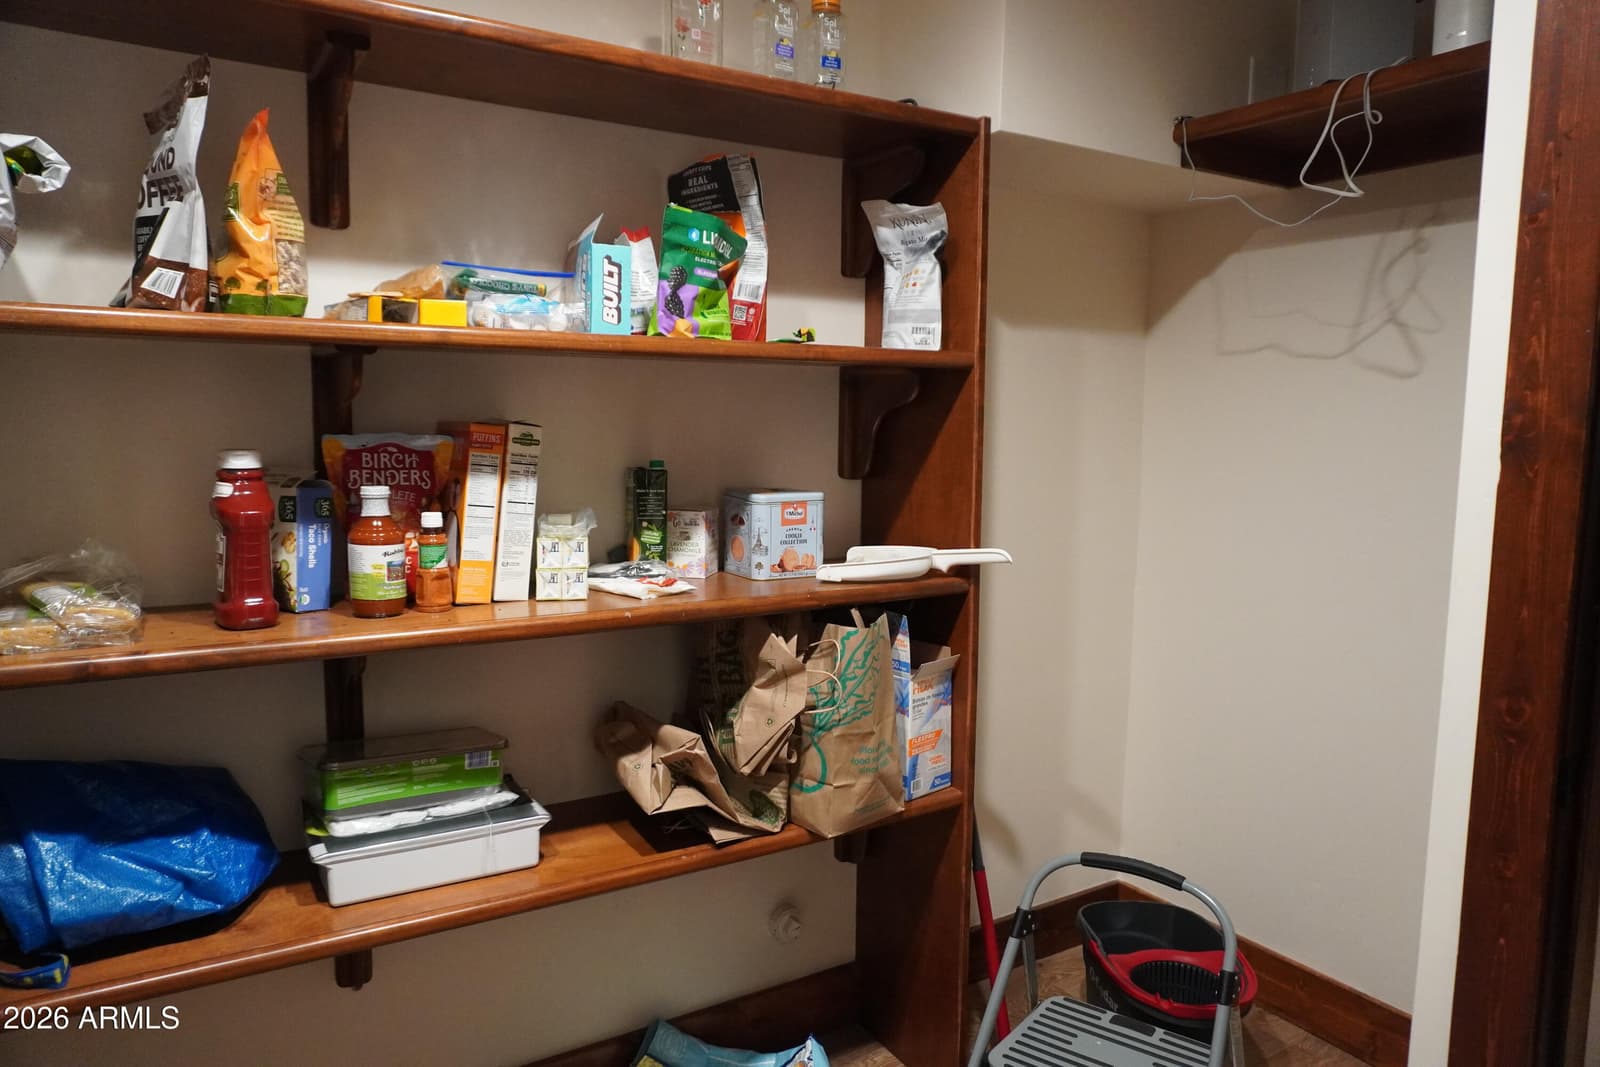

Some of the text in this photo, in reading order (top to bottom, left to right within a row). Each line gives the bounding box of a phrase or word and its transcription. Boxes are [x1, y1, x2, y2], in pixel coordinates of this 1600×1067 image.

[602, 256, 621, 326] BUILT
[361, 452, 420, 468] BIRCH
[347, 469, 432, 489] BENDERS
[307, 524, 318, 568] Taco Shells
